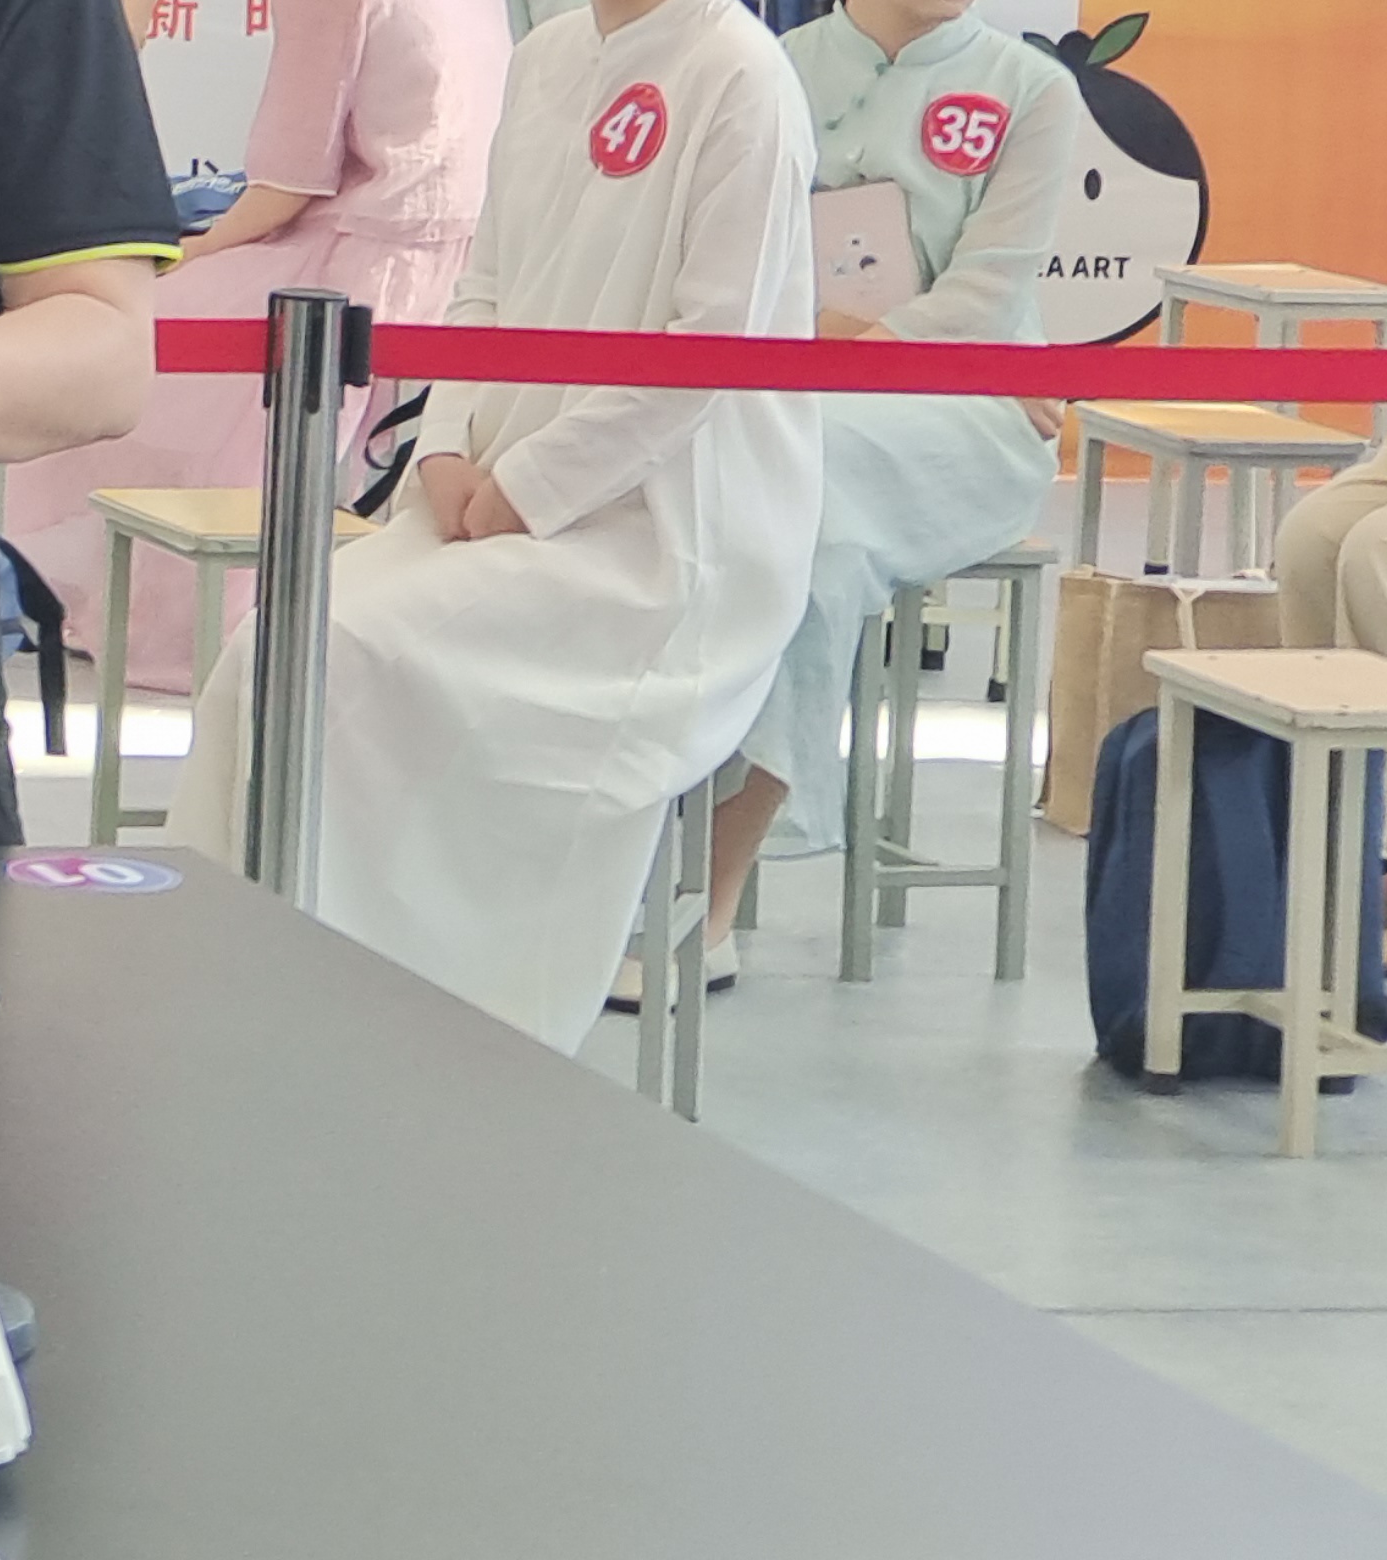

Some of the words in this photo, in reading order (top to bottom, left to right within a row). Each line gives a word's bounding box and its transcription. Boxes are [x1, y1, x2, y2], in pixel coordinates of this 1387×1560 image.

[600, 101, 657, 162] 41
[931, 105, 1000, 159] 35
[1071, 255, 1131, 279] ART
